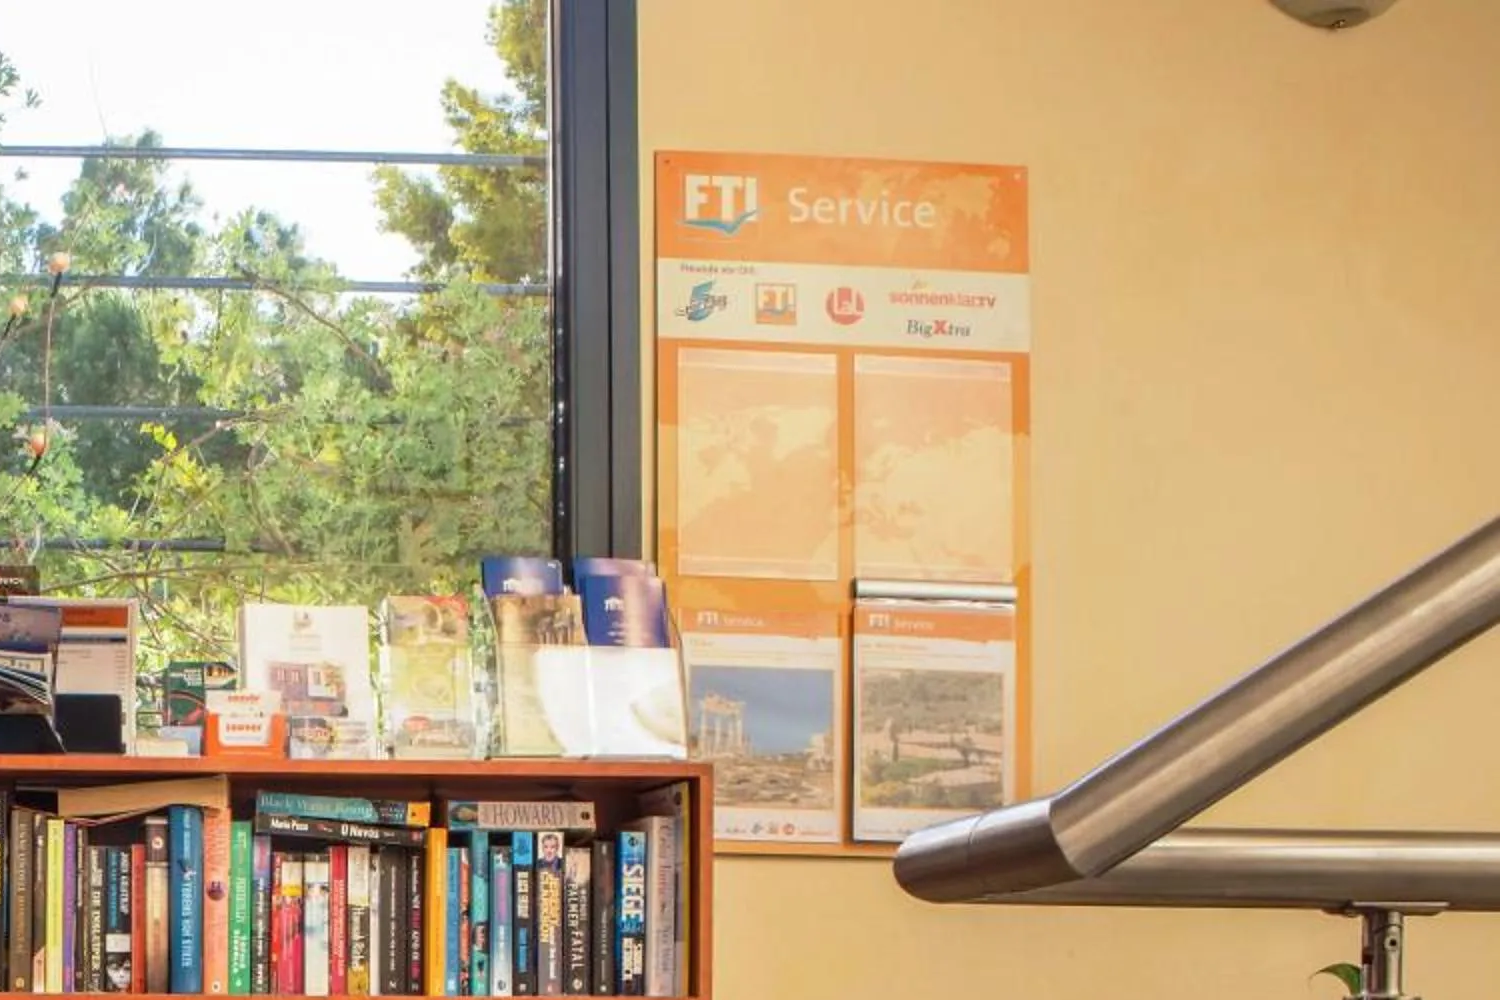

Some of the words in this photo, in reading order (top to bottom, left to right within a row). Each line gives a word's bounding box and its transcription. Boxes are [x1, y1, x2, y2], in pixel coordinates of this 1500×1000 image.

[683, 172, 759, 222] FTI
[787, 187, 937, 229] Service
[905, 318, 971, 338] BigXtra
[491, 802, 565, 825] HOWARD
[567, 883, 580, 928] PALMER
[621, 863, 645, 924] SIEGE
[570, 930, 585, 971] FATAL
